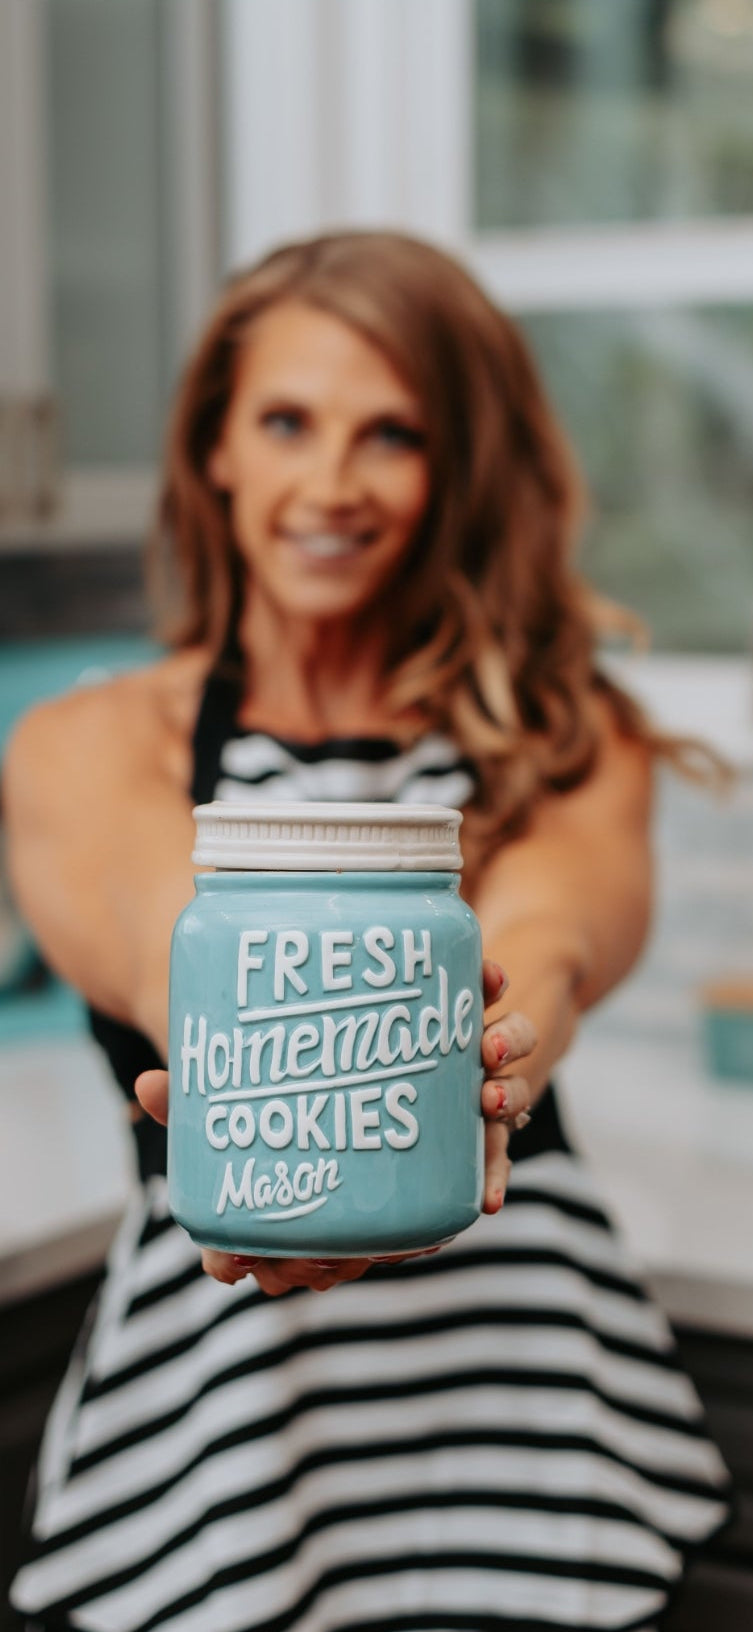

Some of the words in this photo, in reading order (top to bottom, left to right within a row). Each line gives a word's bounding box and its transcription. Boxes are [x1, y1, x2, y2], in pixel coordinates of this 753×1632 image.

[237, 926, 433, 1007] FRESH
[181, 965, 475, 1096] Homemade
[204, 1082, 420, 1151] COOKIES
[215, 1157, 343, 1216] Mason
